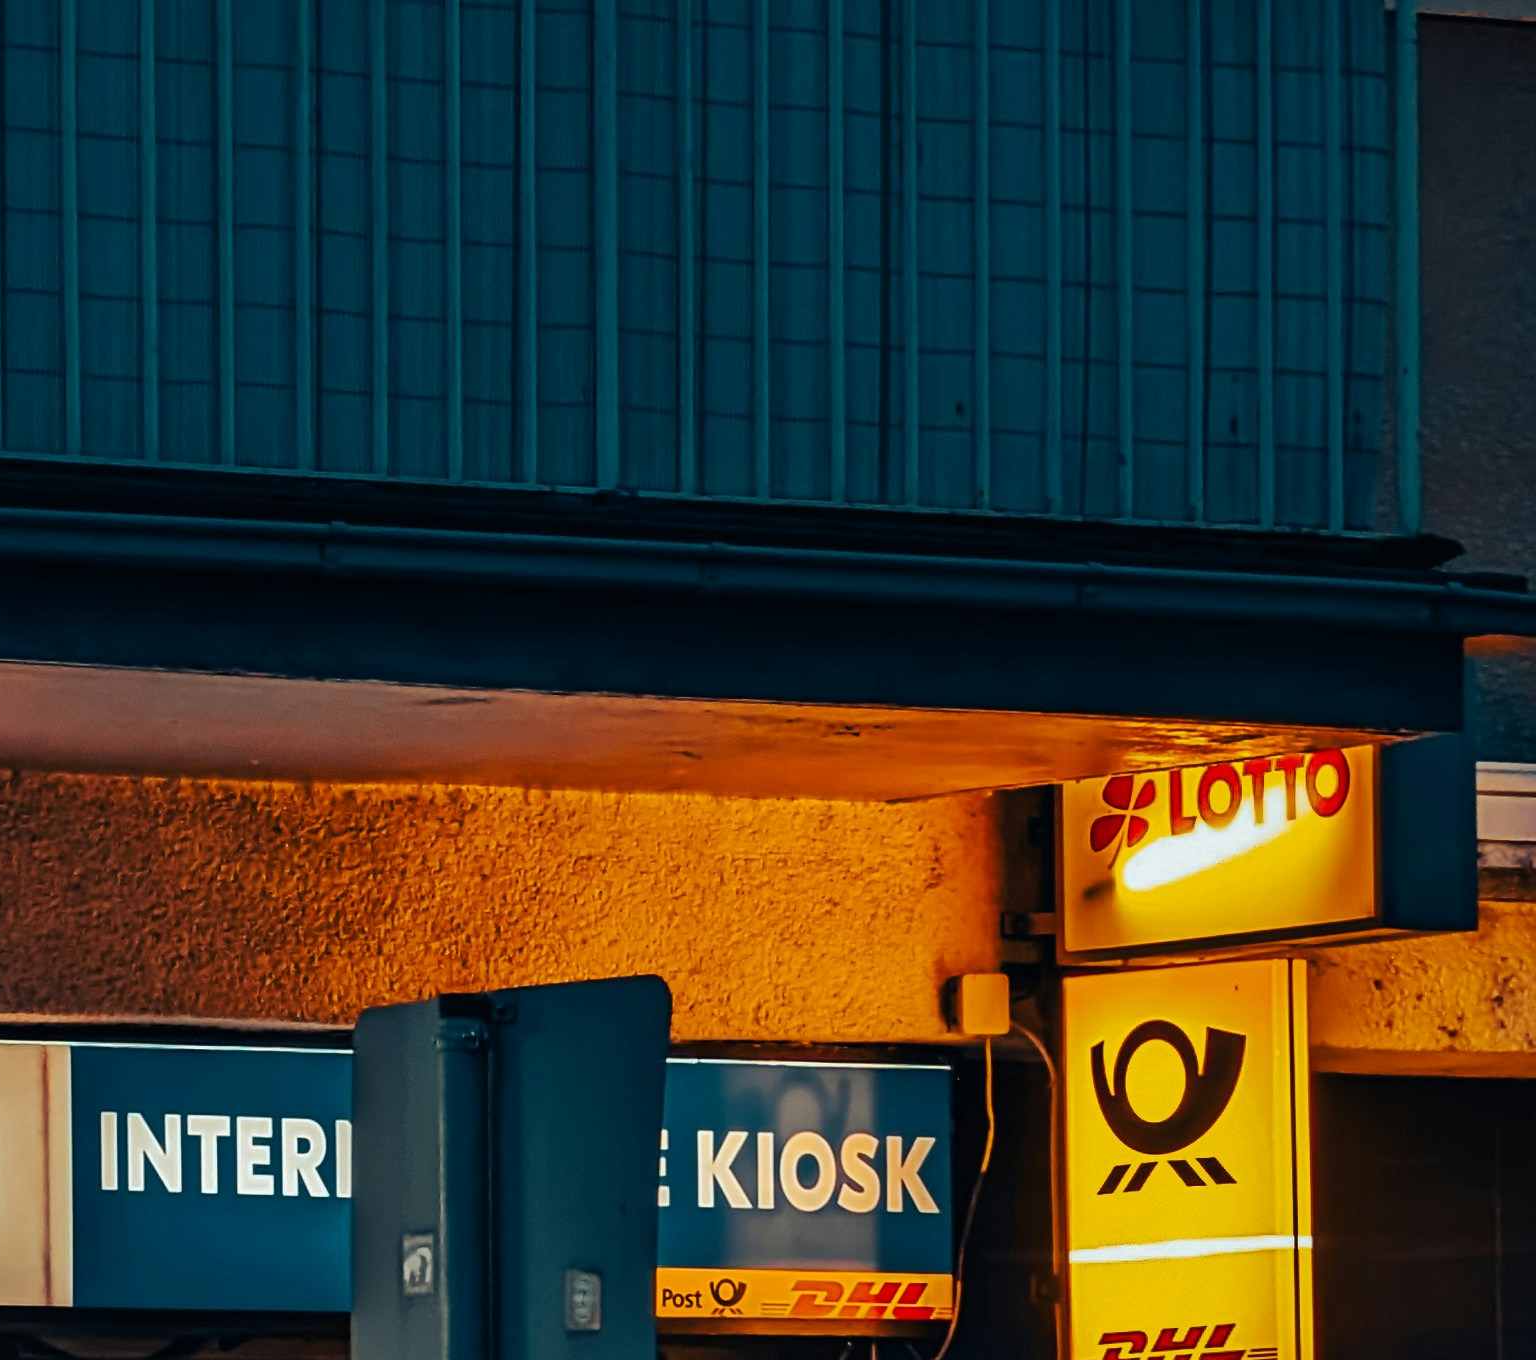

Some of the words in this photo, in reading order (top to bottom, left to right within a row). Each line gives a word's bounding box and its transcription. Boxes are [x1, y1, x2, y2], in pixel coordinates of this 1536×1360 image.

[1169, 748, 1350, 835] LOTTO
[697, 1130, 940, 1214] KIOSK
[662, 1289, 702, 1308] Post
[786, 1280, 936, 1319] DHL
